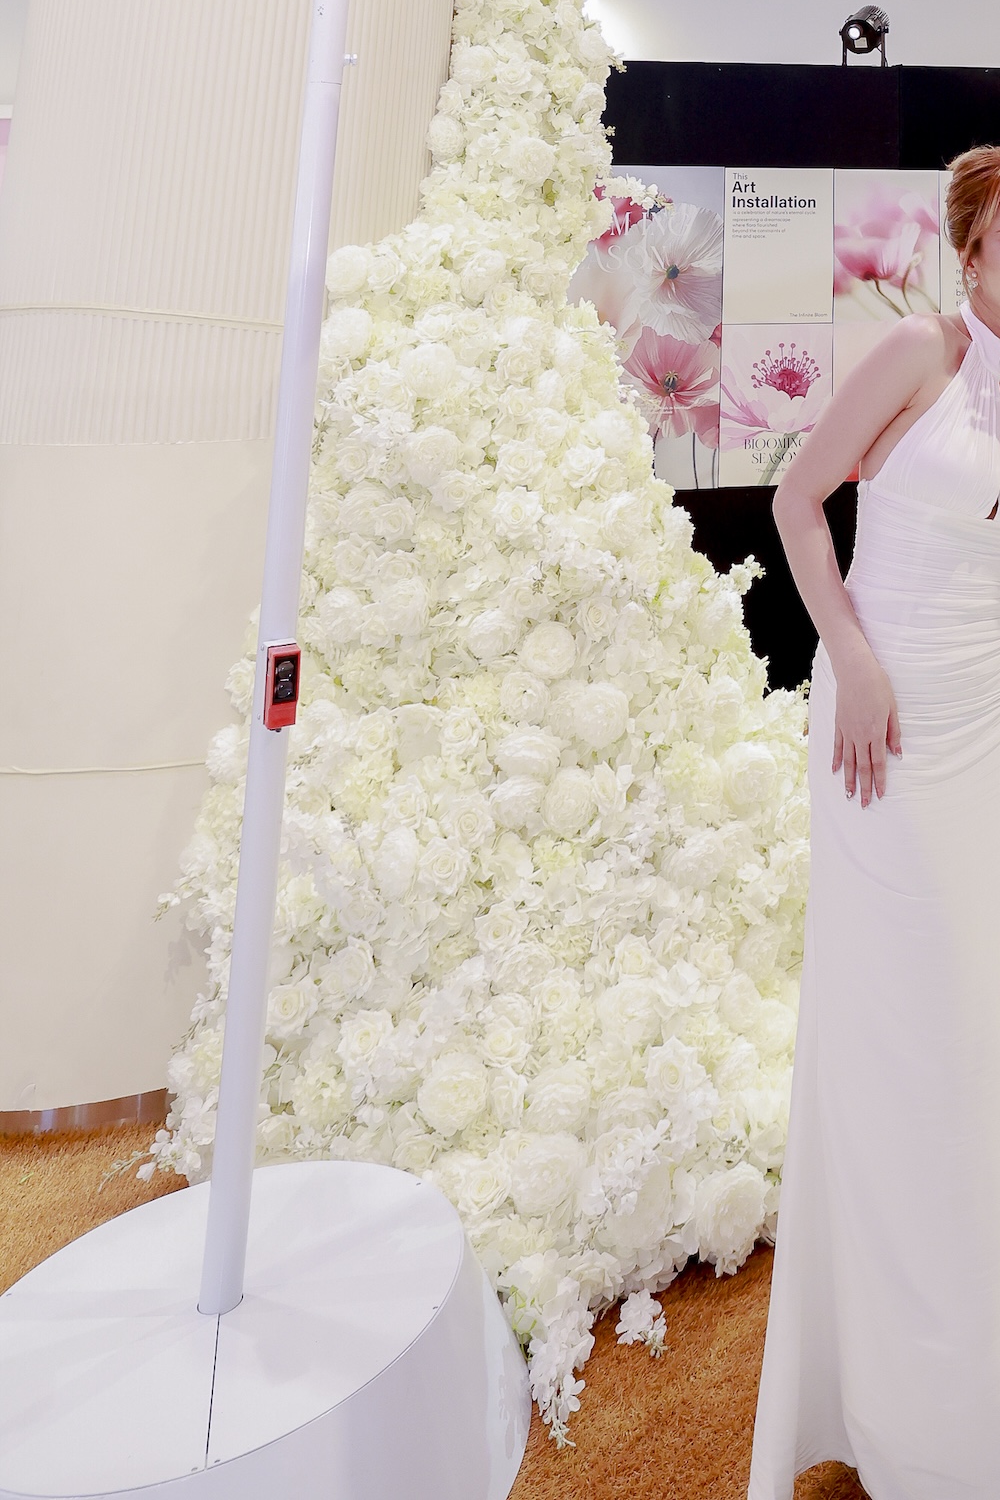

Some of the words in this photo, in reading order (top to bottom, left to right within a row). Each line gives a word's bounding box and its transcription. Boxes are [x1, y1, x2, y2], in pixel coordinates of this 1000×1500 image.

[732, 172, 748, 180] This
[732, 181, 756, 193] Art
[732, 195, 816, 208] Installation
[751, 451, 796, 465] SEASO
